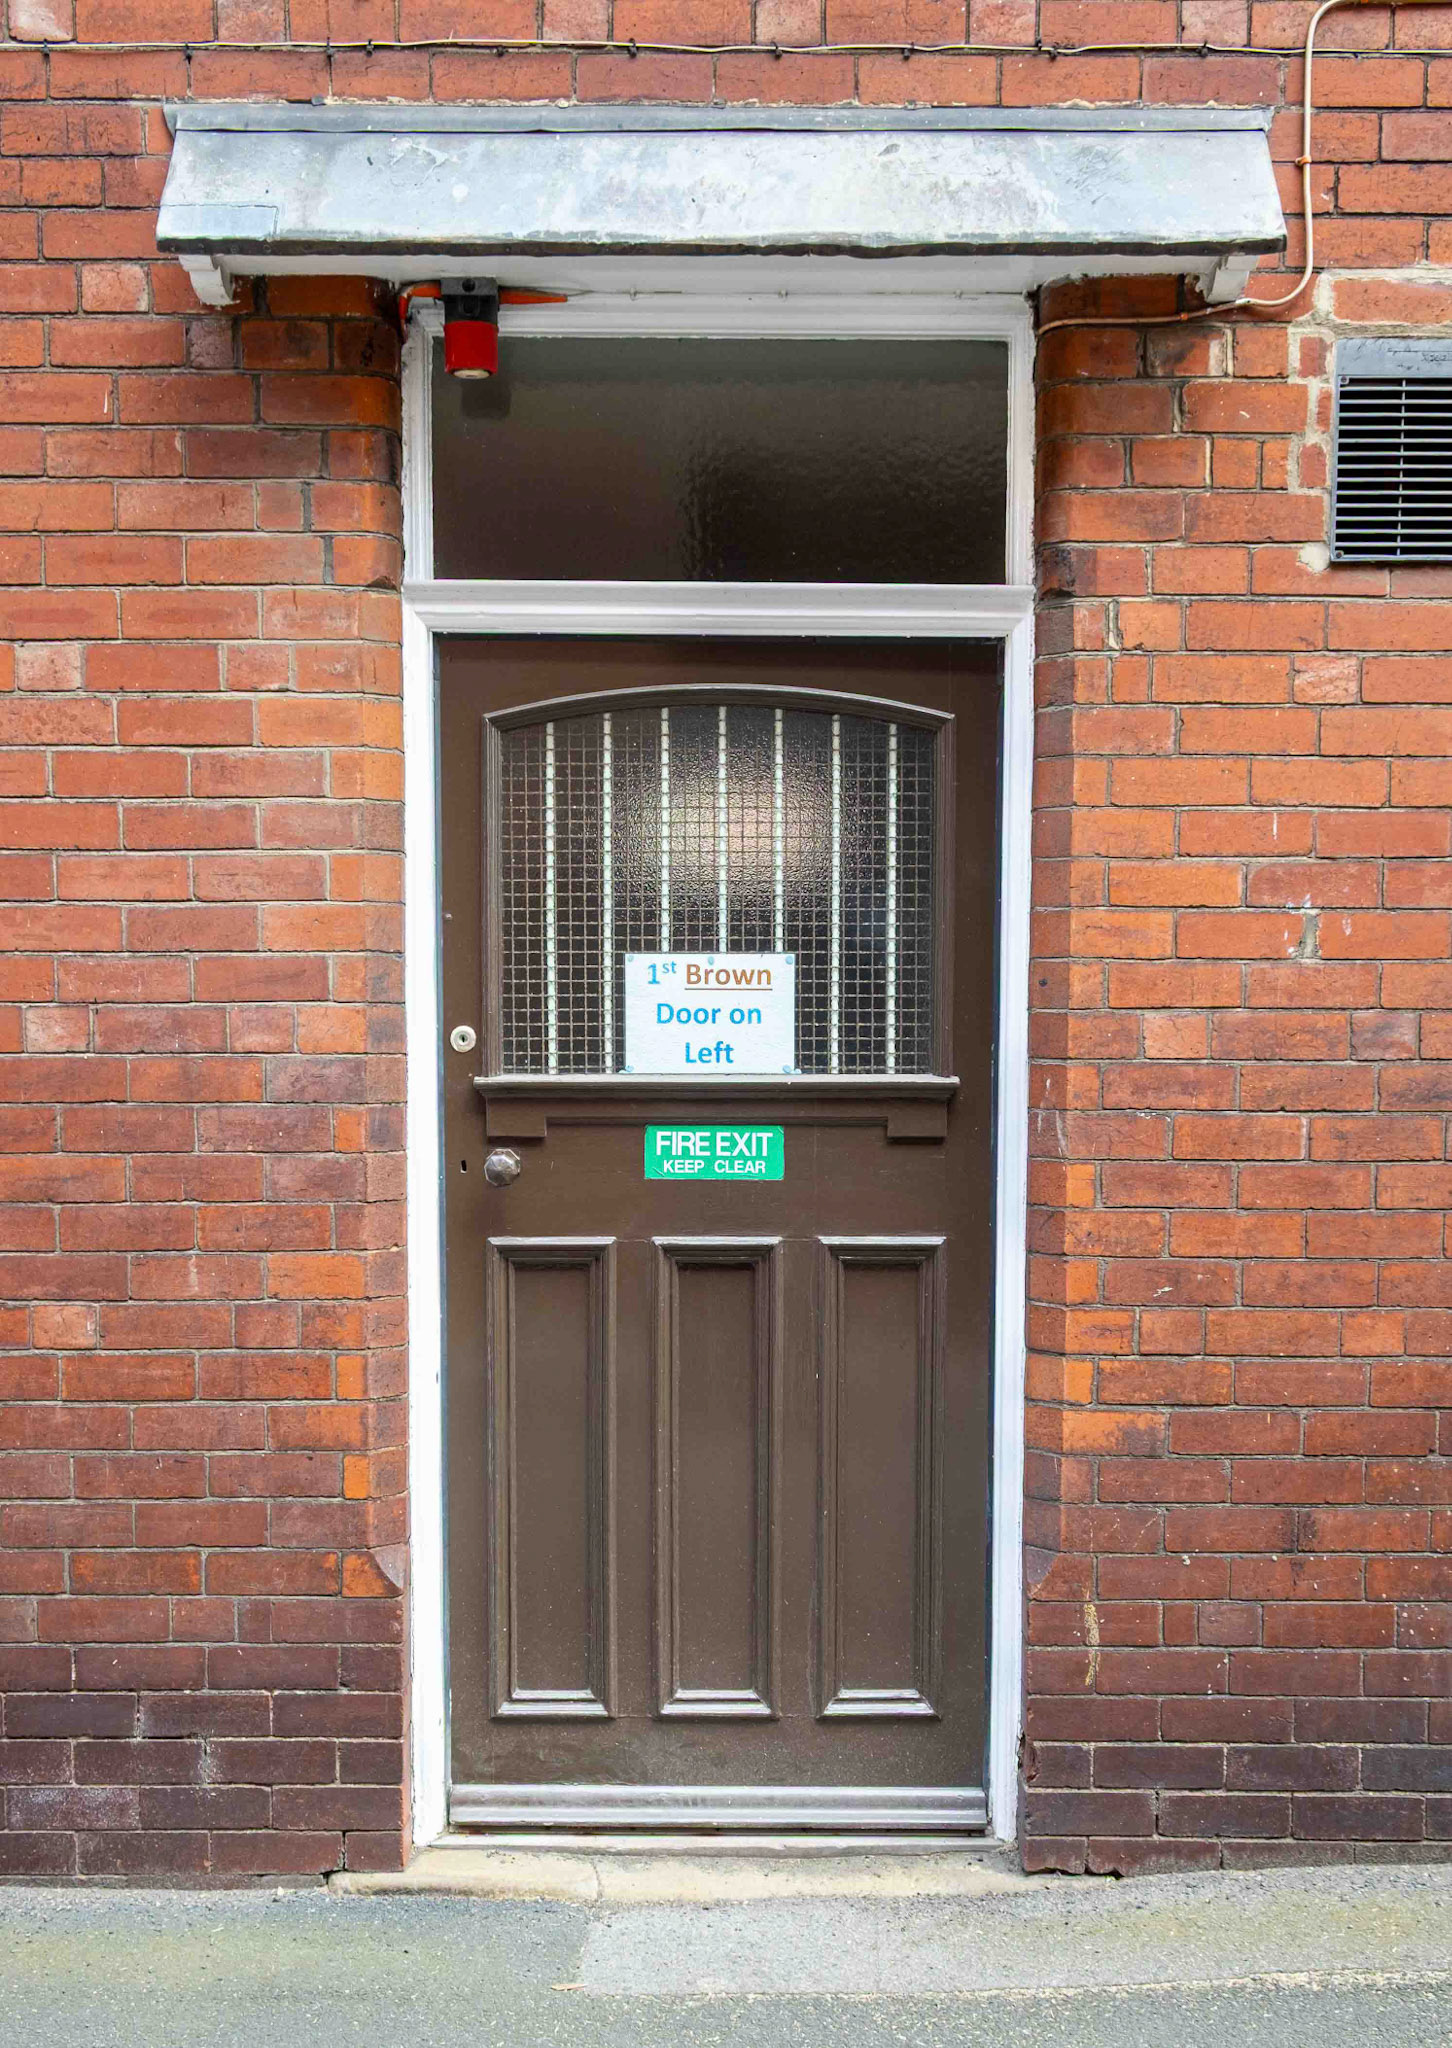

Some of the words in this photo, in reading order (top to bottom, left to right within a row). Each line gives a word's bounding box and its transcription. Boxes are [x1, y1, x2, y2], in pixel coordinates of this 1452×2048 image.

[685, 963, 772, 986] Brown
[656, 1002, 721, 1025] Door
[729, 1006, 762, 1025] on
[685, 1040, 734, 1064] Left
[656, 1131, 711, 1156] FIRE
[716, 1132, 773, 1157] EXIT
[663, 1159, 704, 1173] KEEP
[714, 1160, 766, 1174] CLEAR
